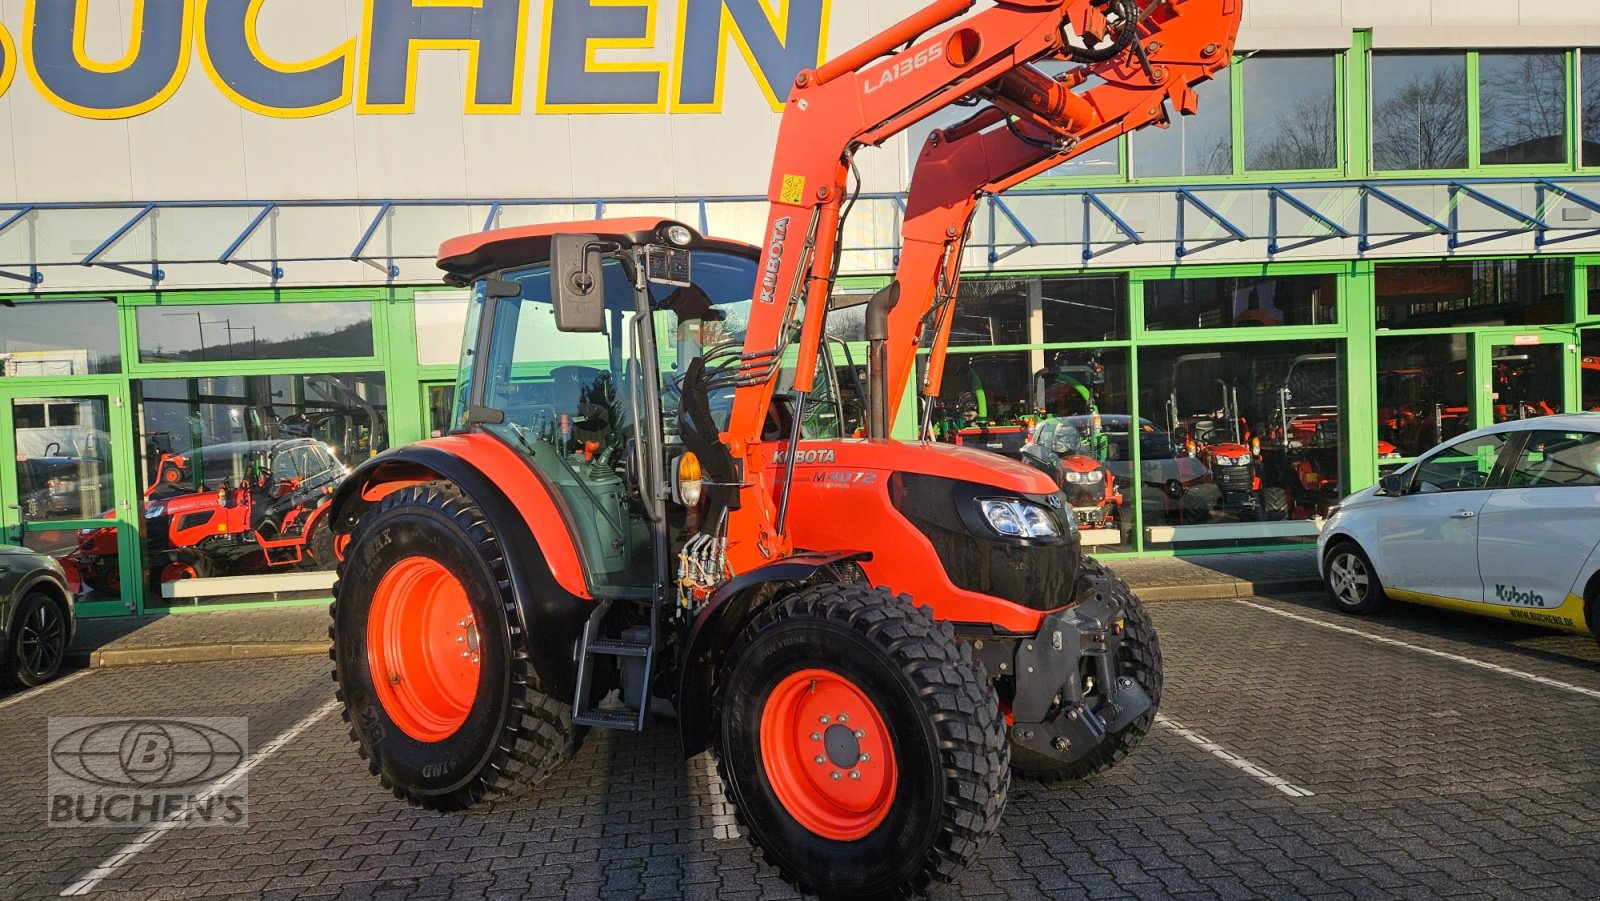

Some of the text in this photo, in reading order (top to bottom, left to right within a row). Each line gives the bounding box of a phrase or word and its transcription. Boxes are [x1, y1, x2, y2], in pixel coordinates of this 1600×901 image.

[0, 0, 831, 121] UCHEN
[864, 41, 943, 94] LA1365
[760, 216, 790, 304] KUBOTA
[772, 449, 835, 464] KBOTA
[813, 471, 876, 484] M4072
[1495, 583, 1544, 607] Kubota
[1508, 608, 1576, 627] WWW.BUCHENS.DE
